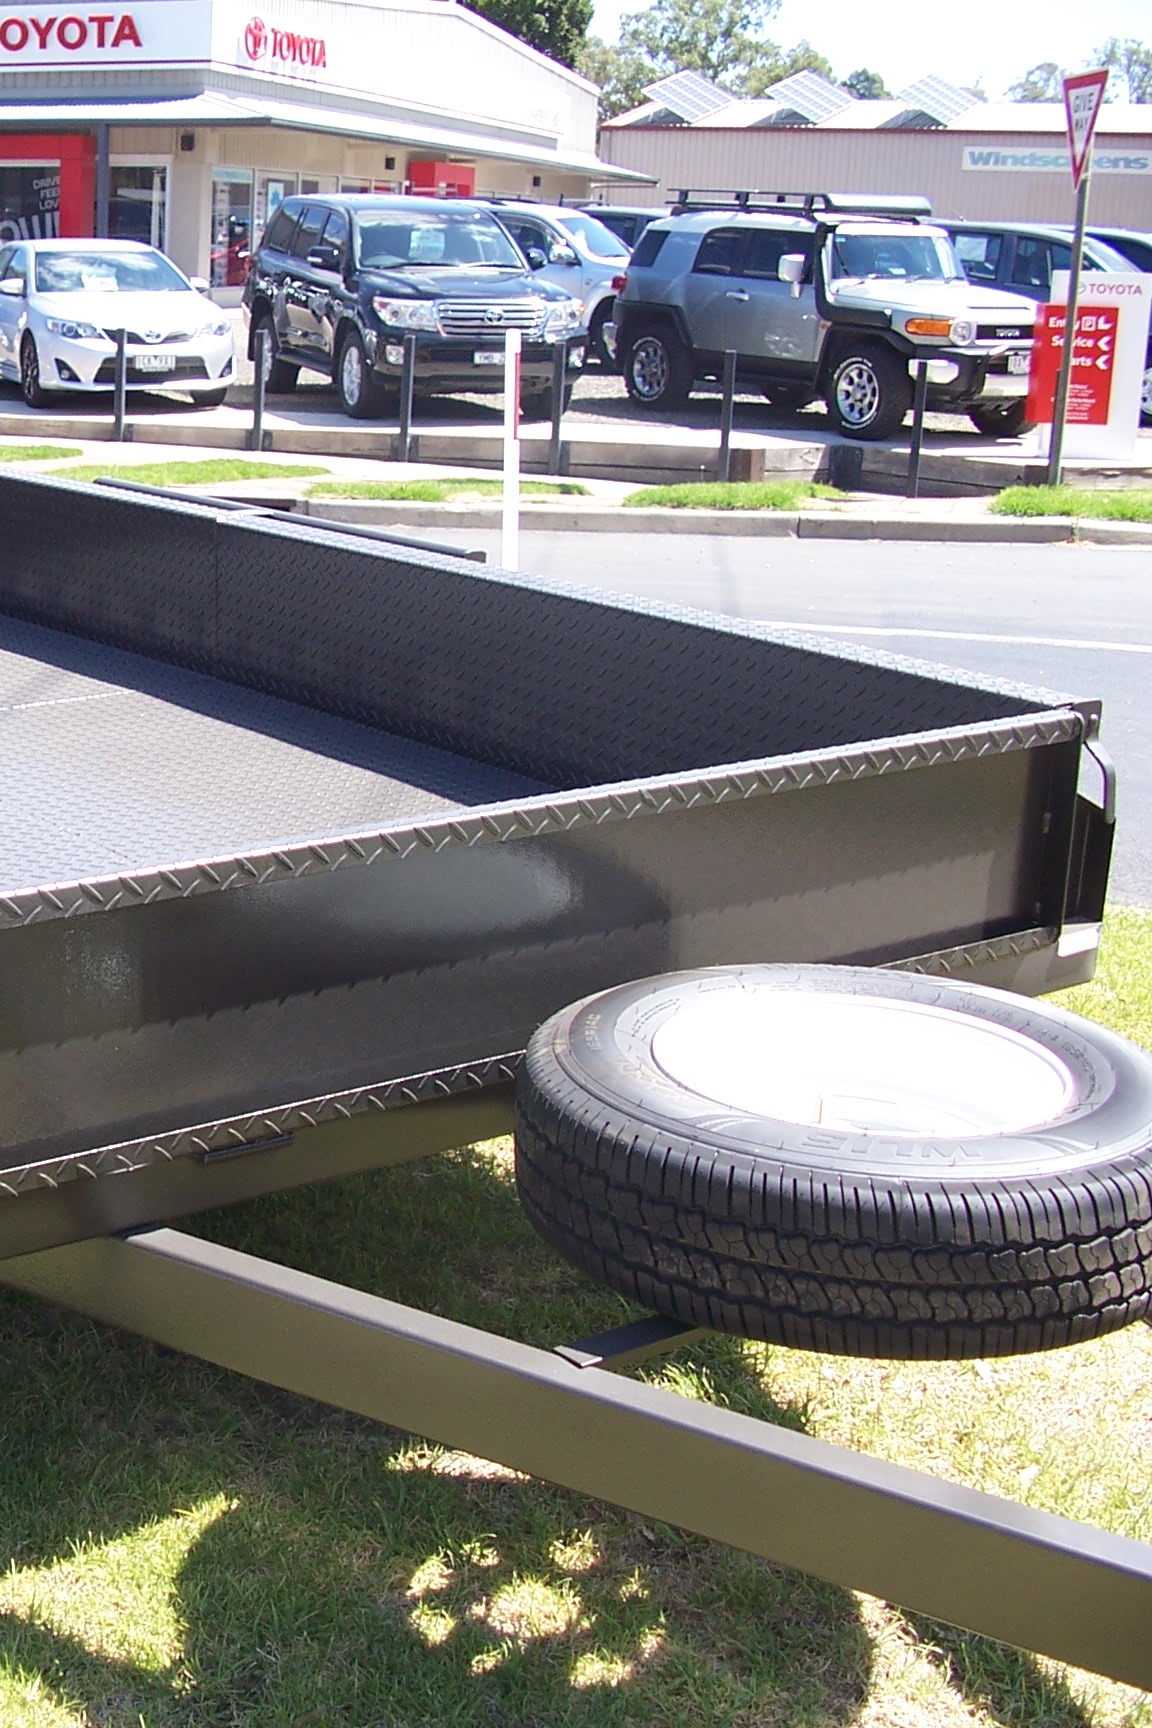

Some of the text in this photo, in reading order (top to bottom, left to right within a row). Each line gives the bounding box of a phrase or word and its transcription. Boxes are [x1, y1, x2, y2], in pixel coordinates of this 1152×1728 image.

[270, 27, 326, 68] TOYOTA
[1073, 92, 1095, 113] GIVE
[968, 151, 1150, 170] Windscens
[1088, 283, 1143, 296] TOYOTA
[995, 328, 1020, 337] TOYOTA
[1069, 356, 1092, 366] arts
